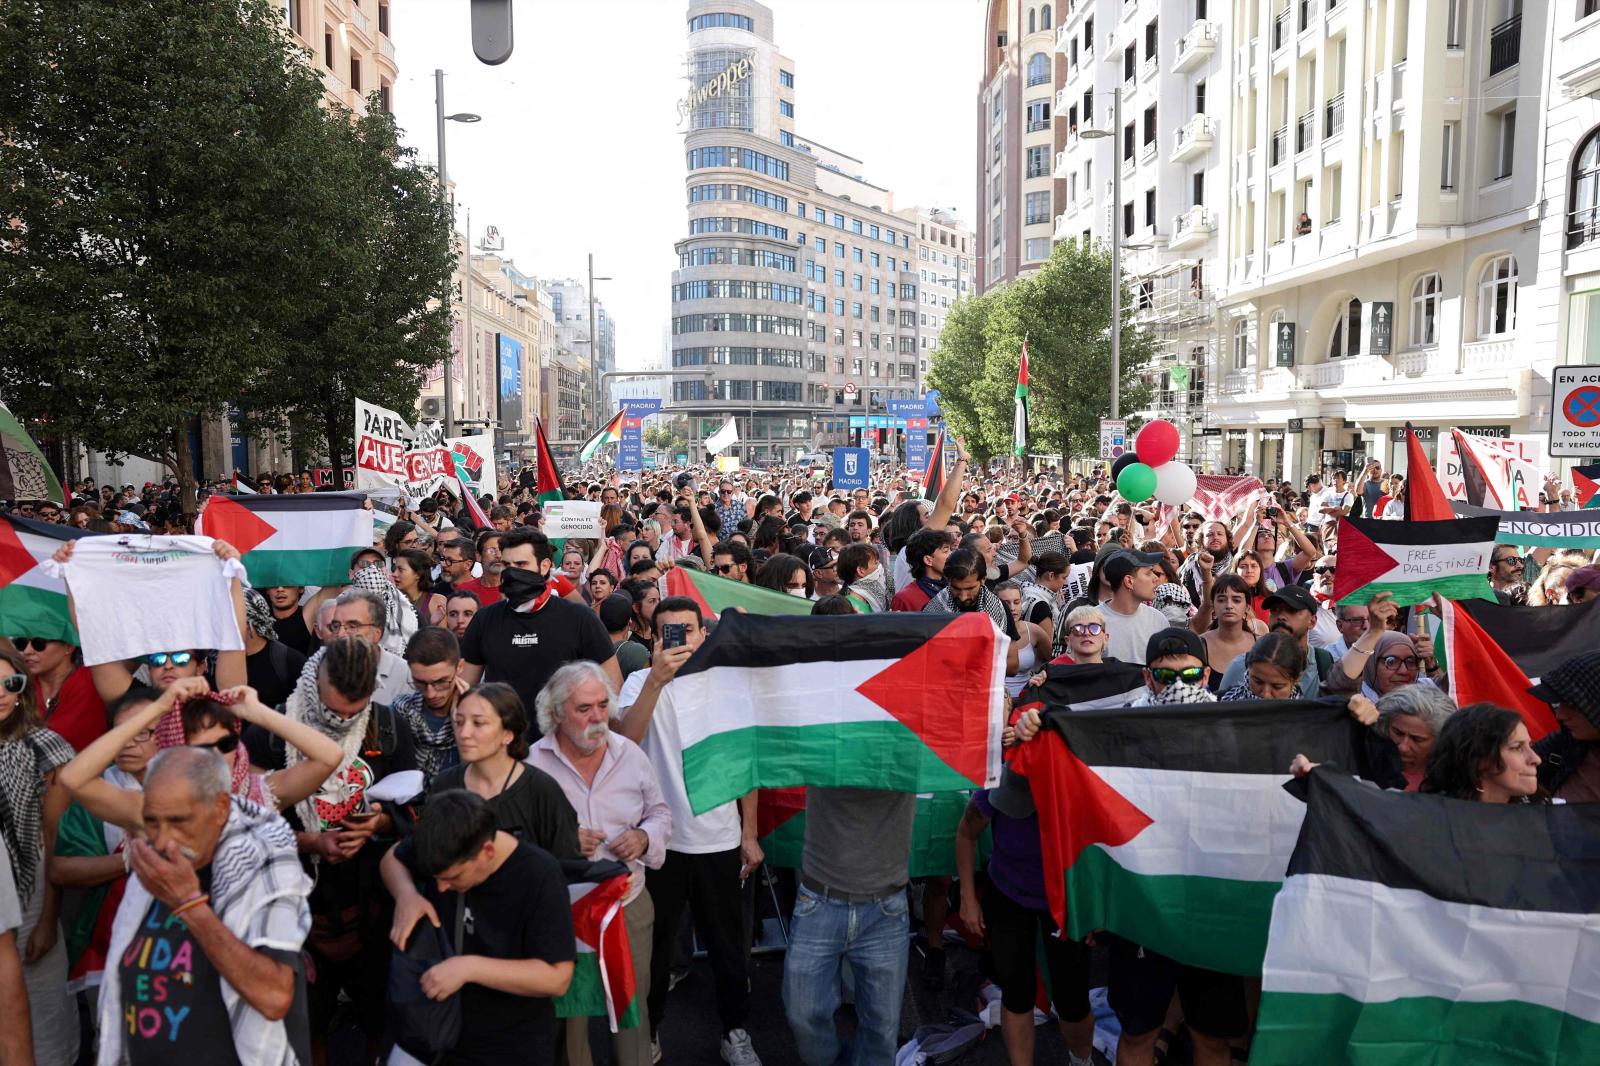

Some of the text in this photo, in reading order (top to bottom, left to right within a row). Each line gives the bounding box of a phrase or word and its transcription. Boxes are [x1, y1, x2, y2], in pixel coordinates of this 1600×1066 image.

[1407, 549, 1437, 562] FREE
[511, 637, 539, 645] PALESTINE
[147, 900, 188, 930] LA
[137, 974, 168, 1001] ES
